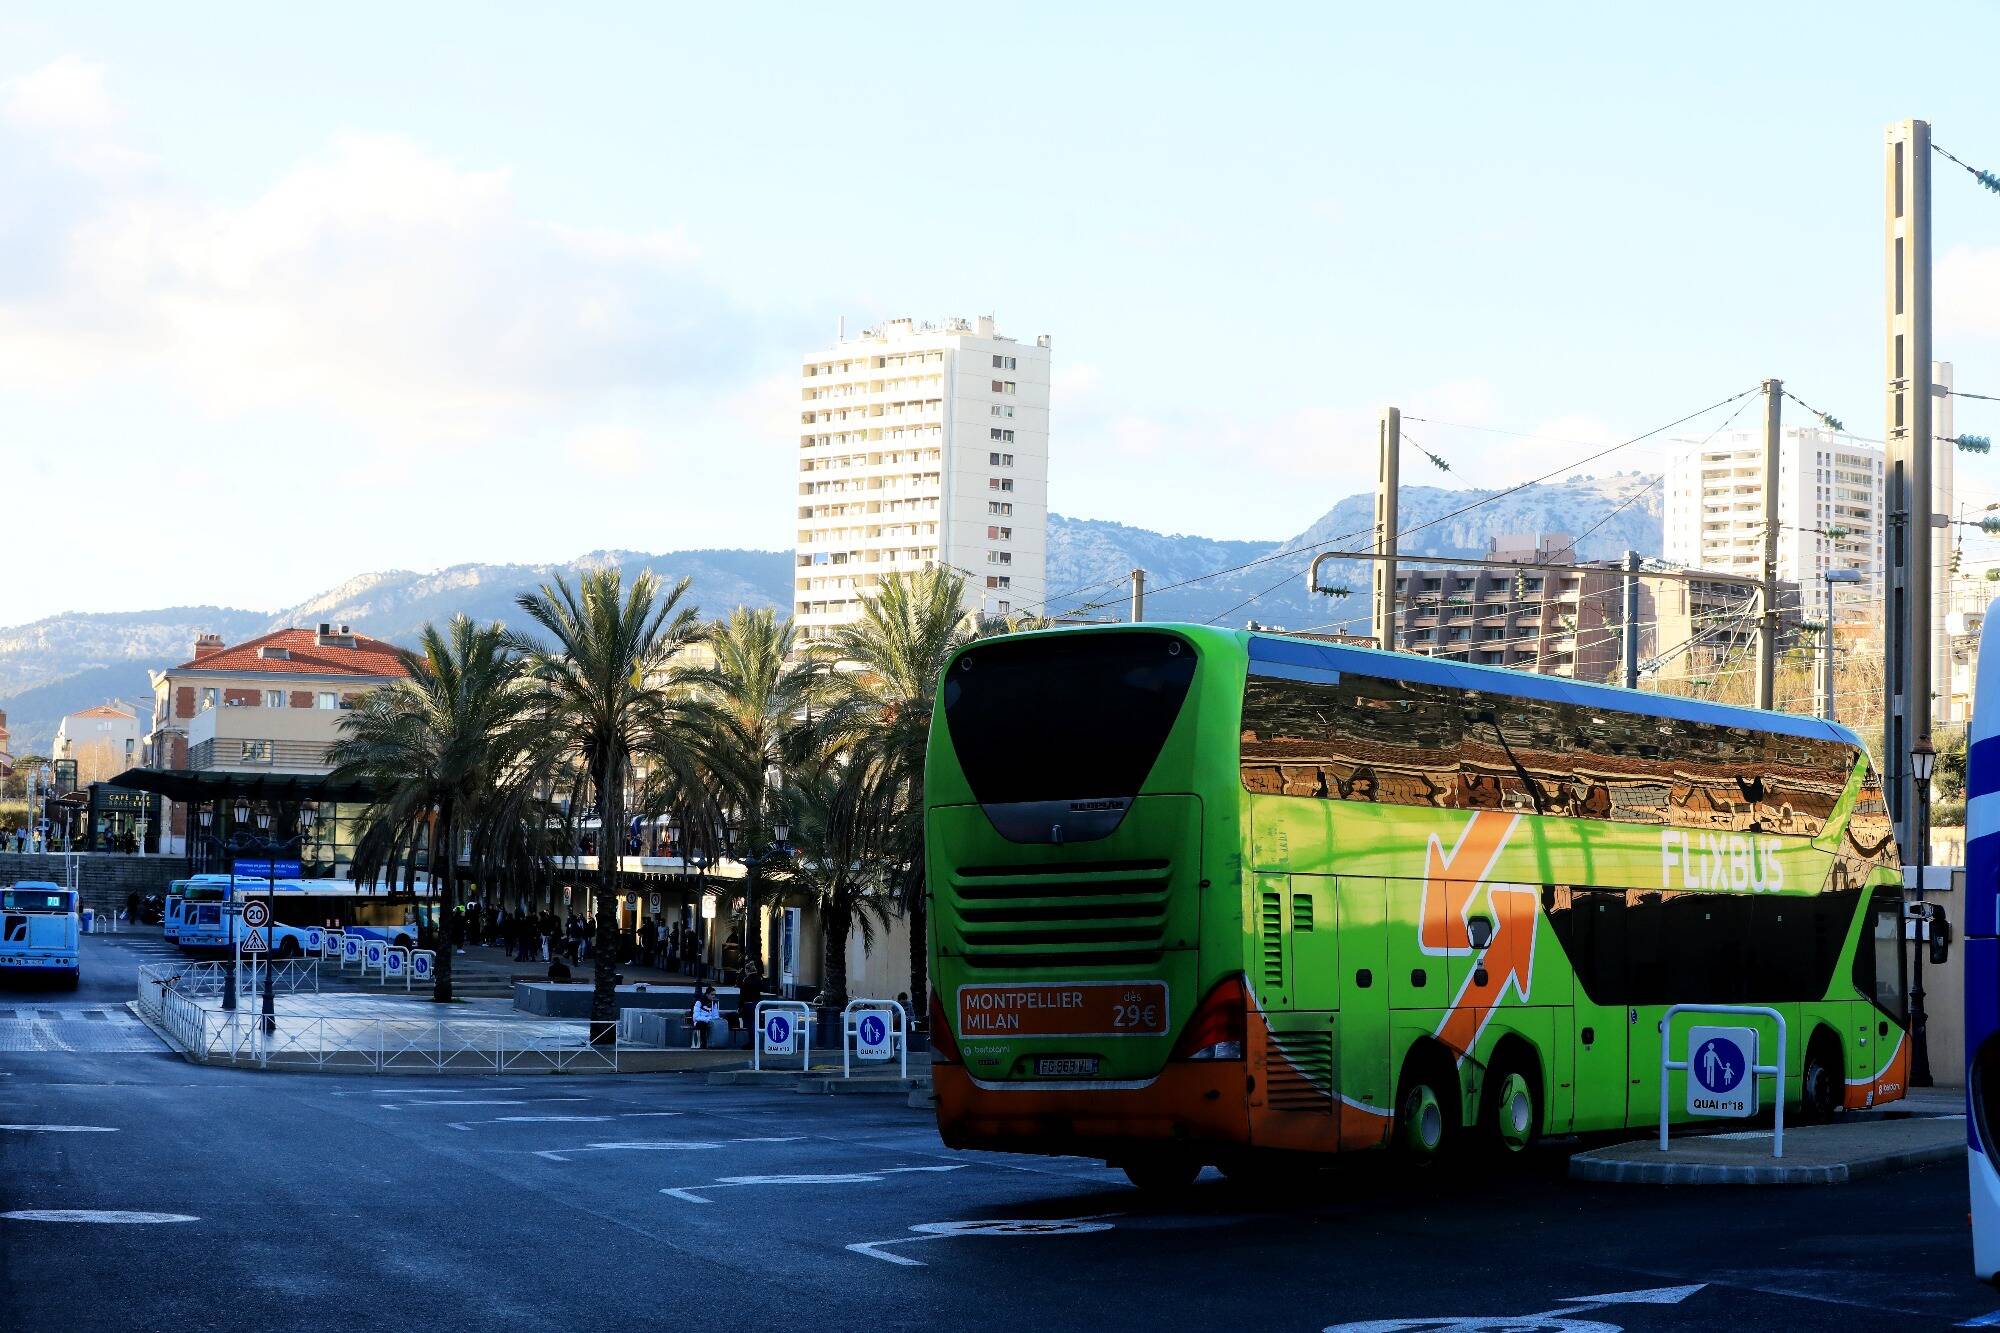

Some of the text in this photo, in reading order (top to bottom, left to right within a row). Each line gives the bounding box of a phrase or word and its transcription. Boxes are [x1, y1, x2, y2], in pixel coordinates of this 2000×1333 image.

[48, 897, 60, 906] 70
[248, 909, 263, 919] 20
[966, 991, 1083, 1010] MONTPELLIER
[1123, 990, 1142, 1002] dès
[967, 1013, 1020, 1029] MILAN
[1113, 1004, 1157, 1027] 29€
[1693, 1099, 1744, 1111] QUAI n°18
